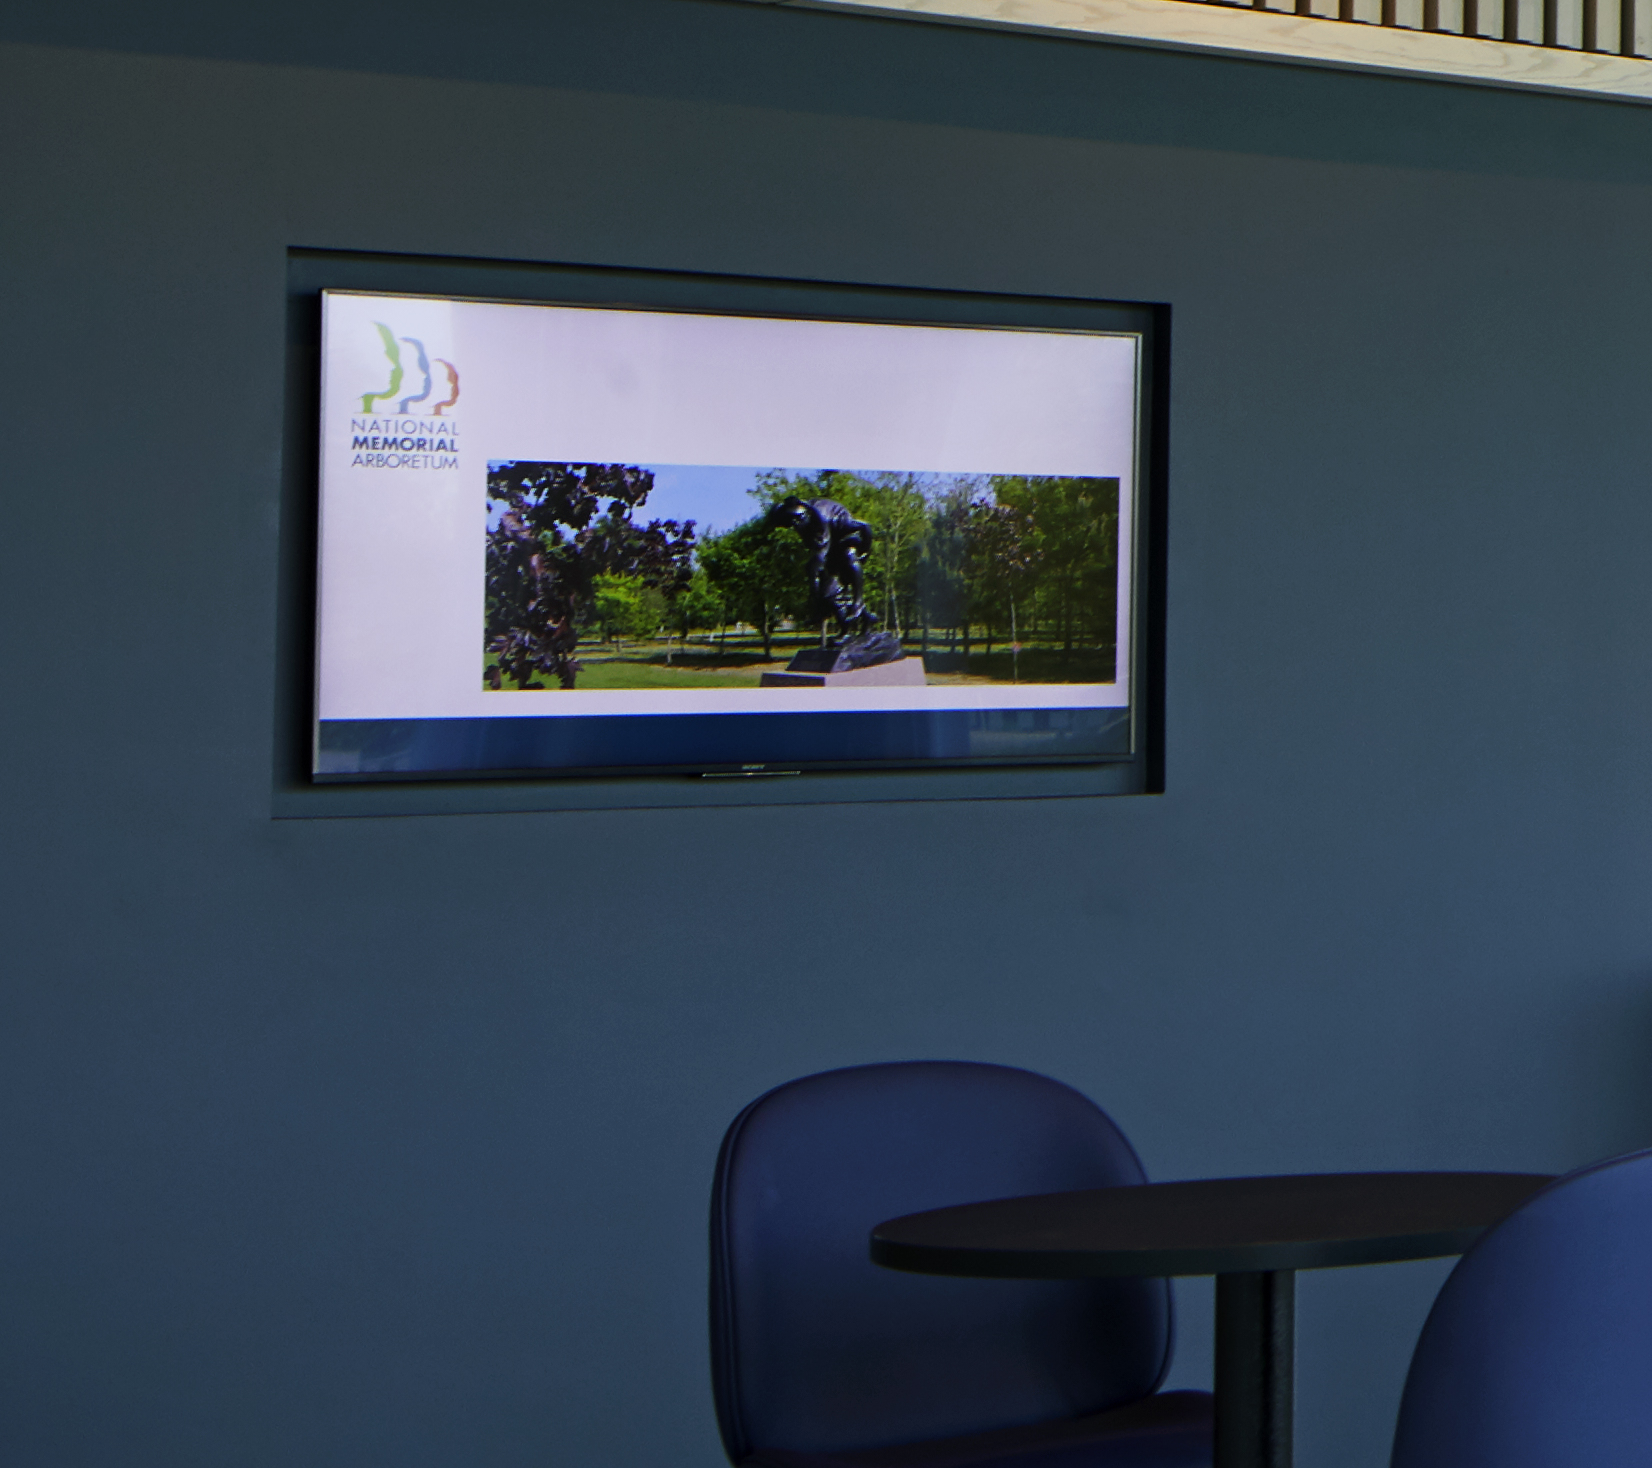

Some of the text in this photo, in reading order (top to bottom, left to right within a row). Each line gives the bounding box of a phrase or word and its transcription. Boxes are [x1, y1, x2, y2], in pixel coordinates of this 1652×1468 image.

[351, 418, 459, 436] NATIONAL
[351, 435, 459, 452] MEMORIAL
[351, 453, 459, 470] ARBORETUM
